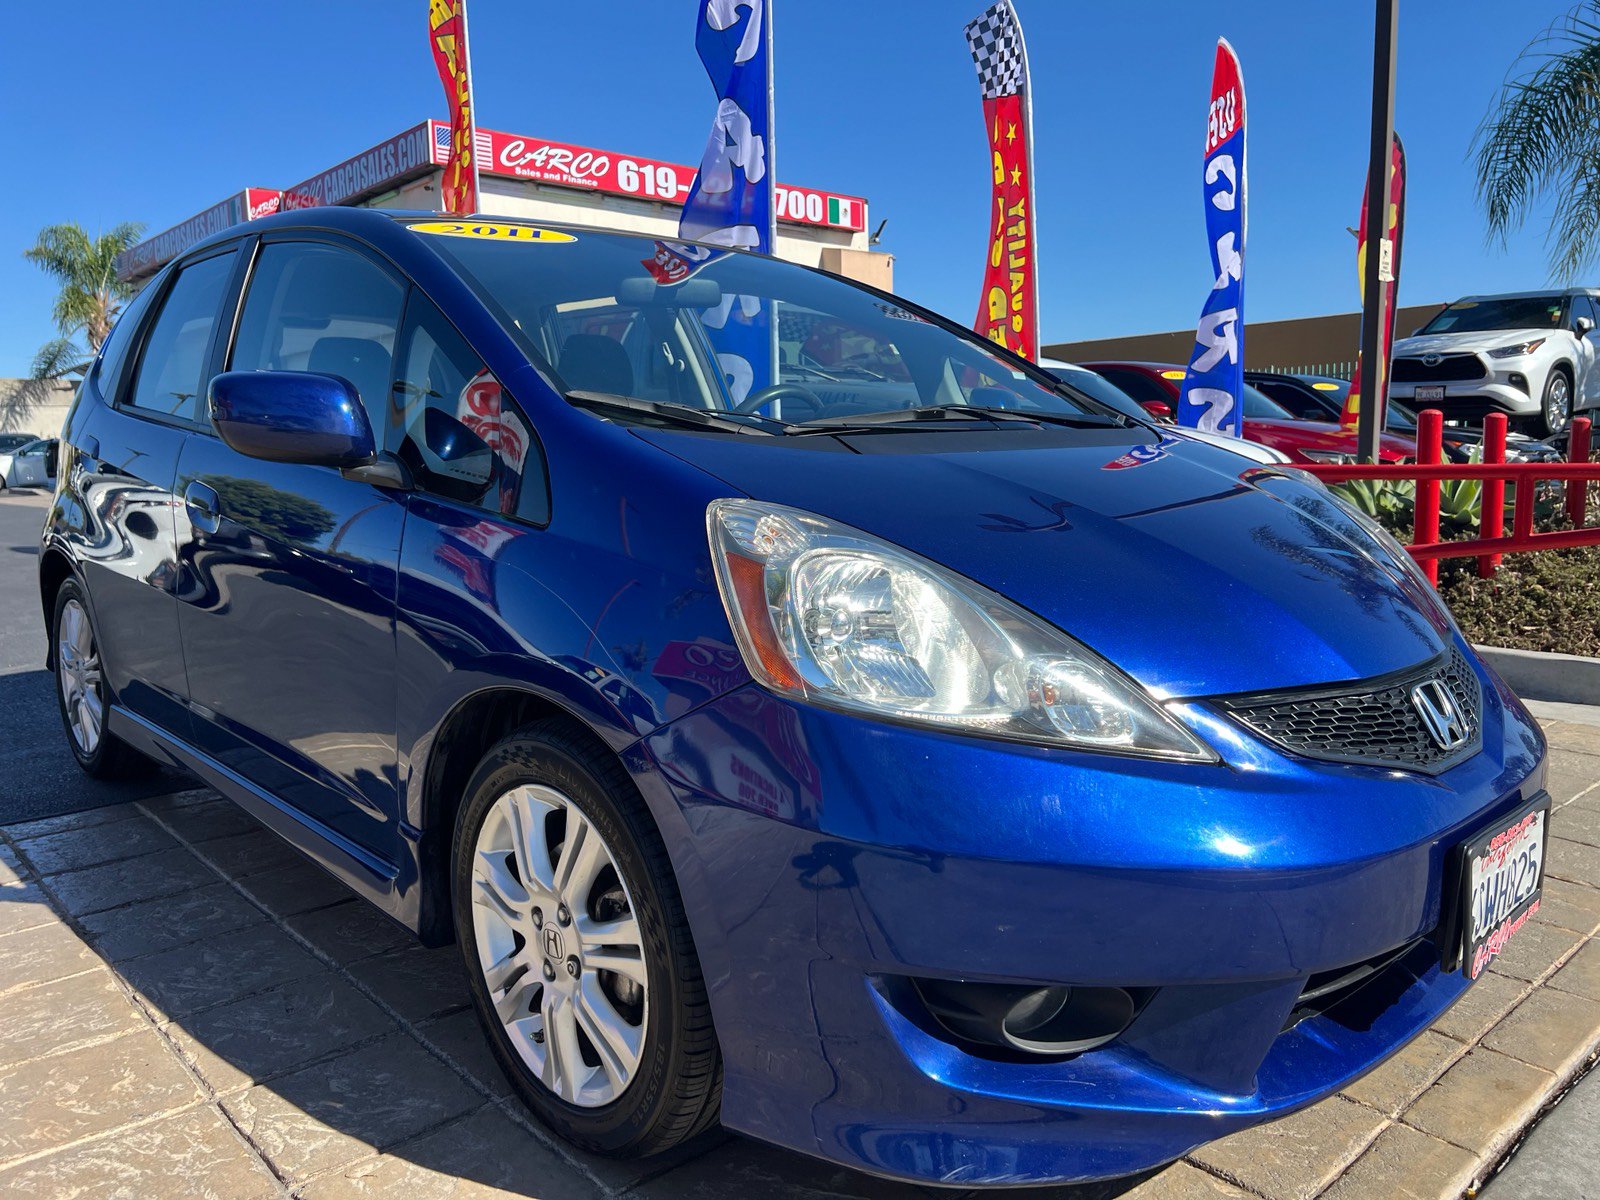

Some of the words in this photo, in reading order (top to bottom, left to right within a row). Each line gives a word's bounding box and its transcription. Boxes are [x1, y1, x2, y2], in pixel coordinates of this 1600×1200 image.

[324, 126, 427, 206] CARCOSALES.COM
[500, 140, 610, 178] CARCO
[515, 166, 541, 178] Sales
[543, 172, 560, 181] and
[562, 174, 598, 187] Finance
[617, 160, 697, 199] 619-
[251, 197, 280, 217] CARCO
[440, 225, 542, 240] 2011
